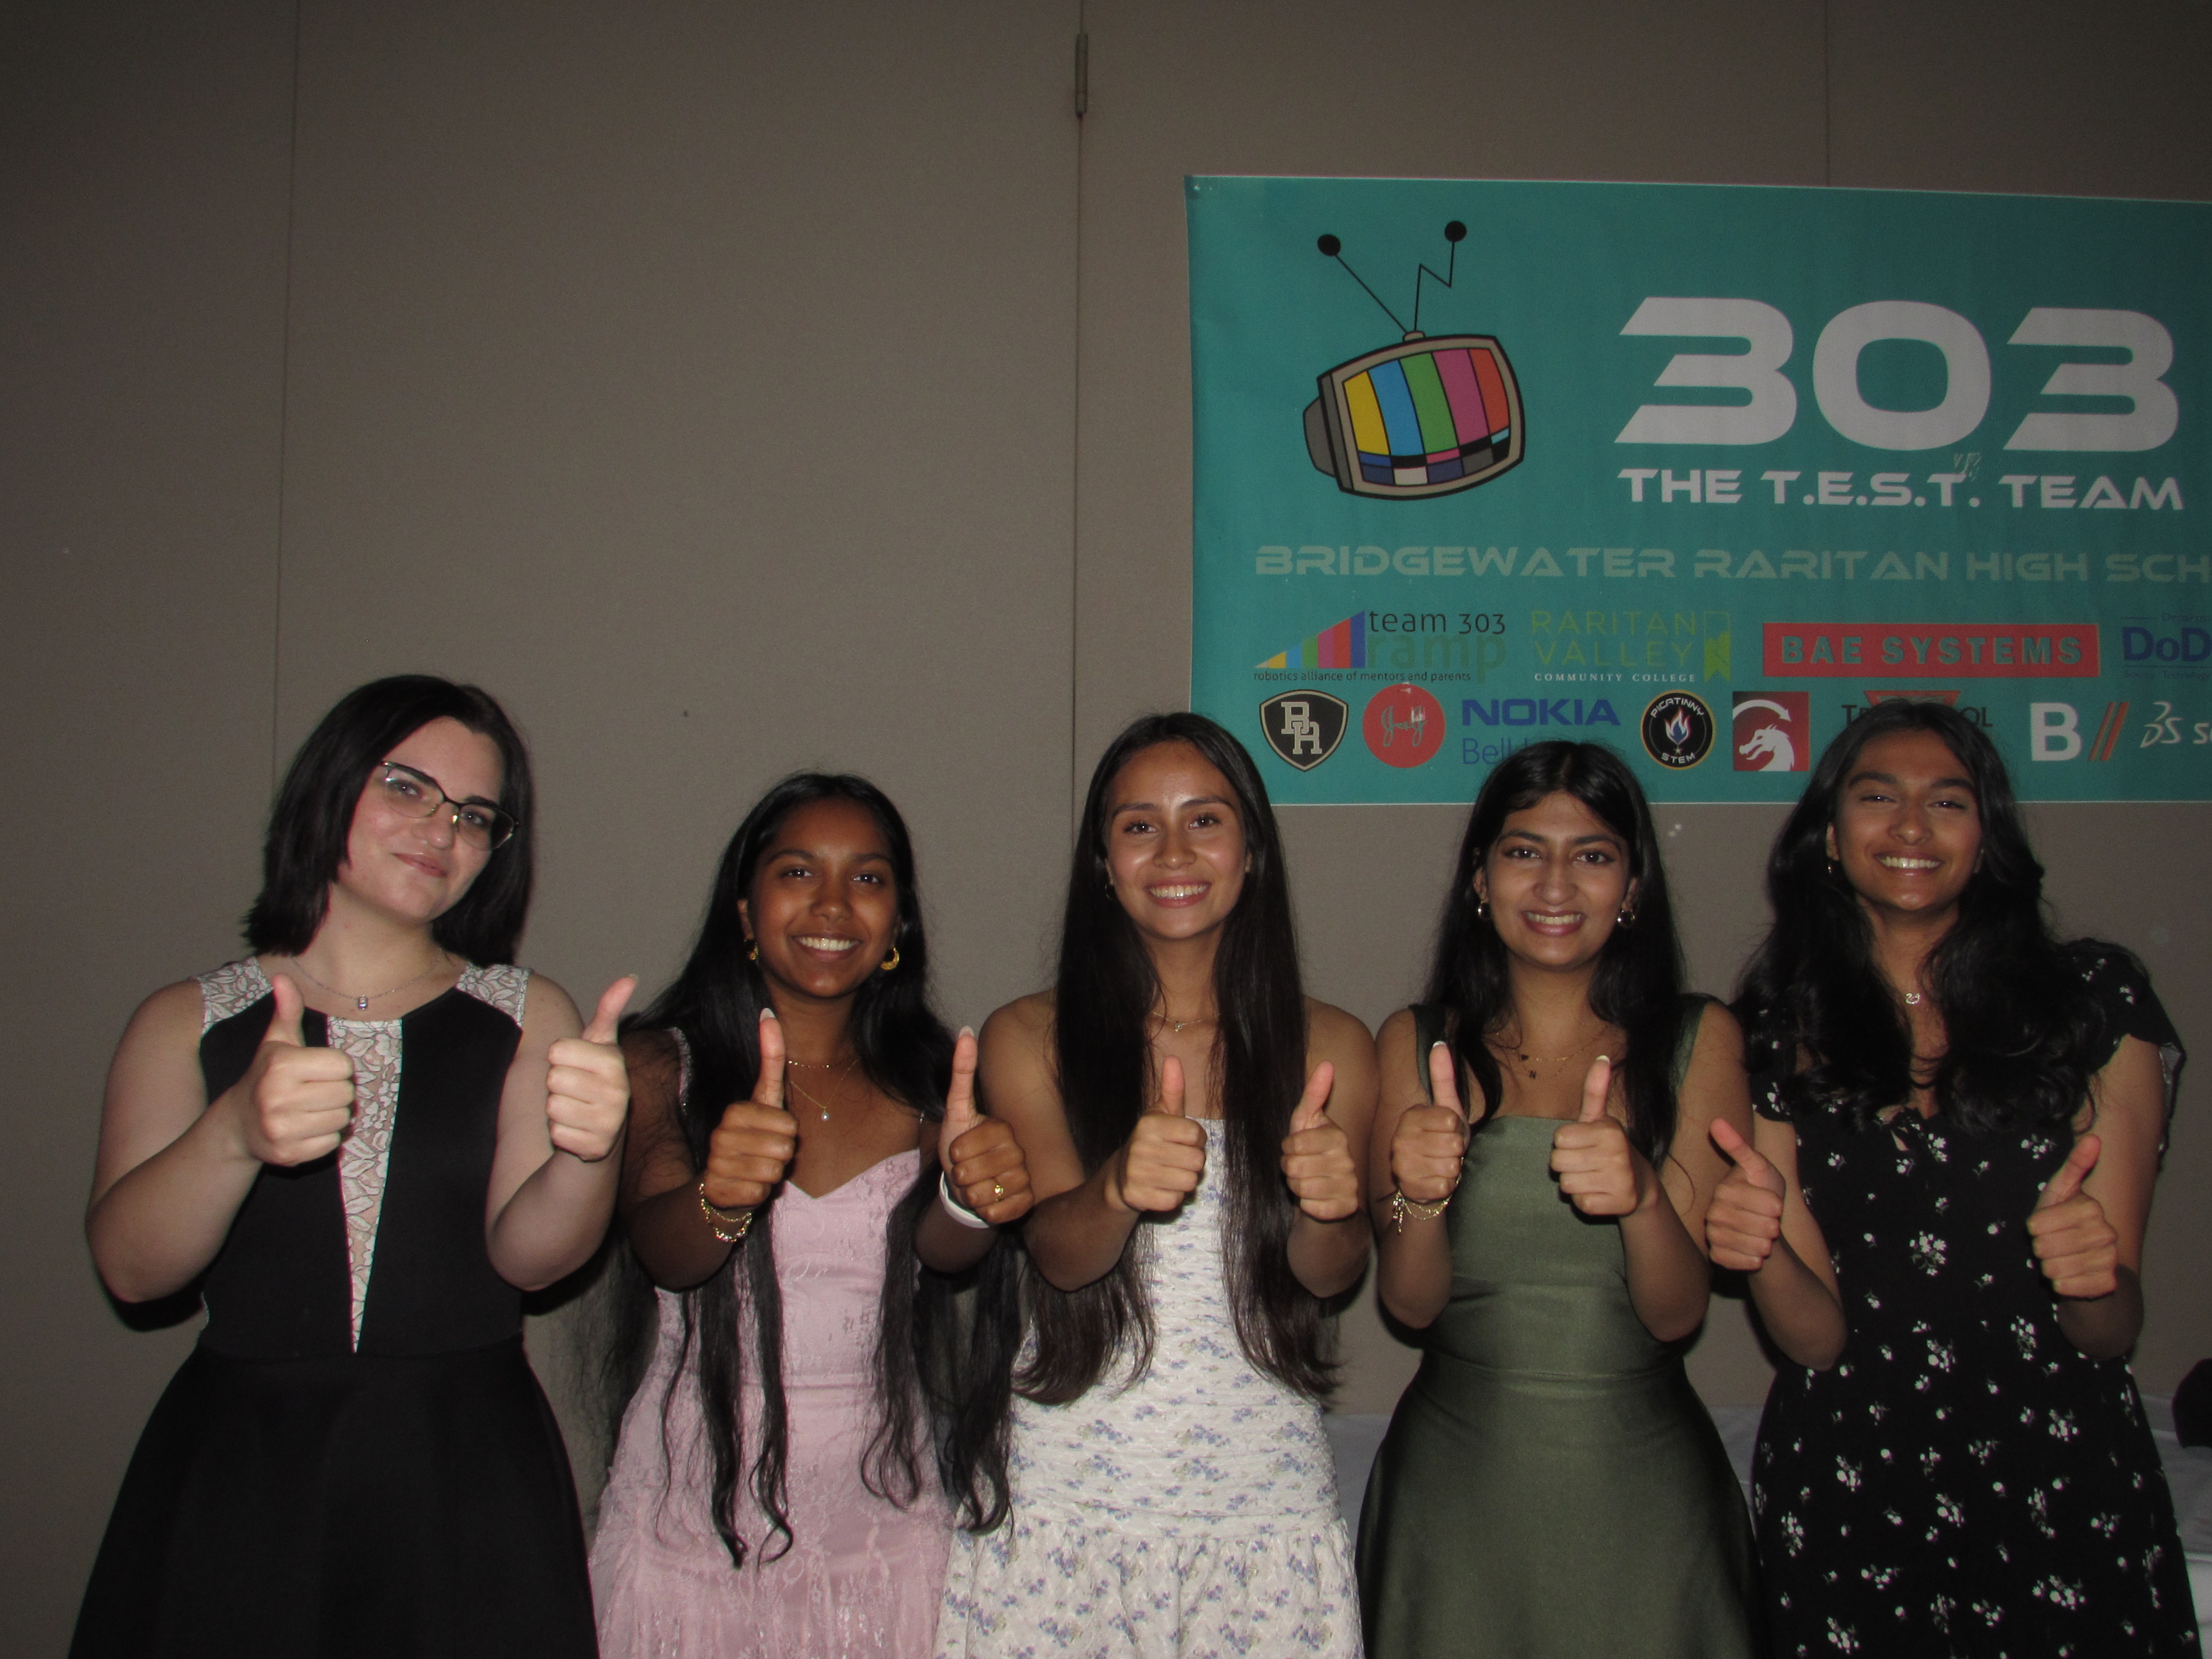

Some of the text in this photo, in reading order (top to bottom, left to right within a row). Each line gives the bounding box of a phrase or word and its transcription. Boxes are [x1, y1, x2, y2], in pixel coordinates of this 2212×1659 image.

[1614, 296, 2179, 451] 303
[1618, 468, 2183, 510] THE T.E.S.T. TEAM
[1255, 545, 2211, 583] BRIDGEWATER RARITAN HIGH SCH
[1369, 611, 1506, 635] team 303
[1531, 609, 1697, 636] RARITAN
[1368, 633, 1507, 684] ramp
[1534, 639, 1693, 666] VALLEY
[1782, 635, 2083, 665] BAE SYSTEMS
[1254, 671, 1471, 684] robotics alliance of mentors and parents
[1534, 673, 1696, 683] COMMUNITY COLLEGE
[1462, 698, 1621, 727] NOKIA
[1650, 697, 1704, 718] PICATINNY
[1661, 752, 1696, 764] STEM
